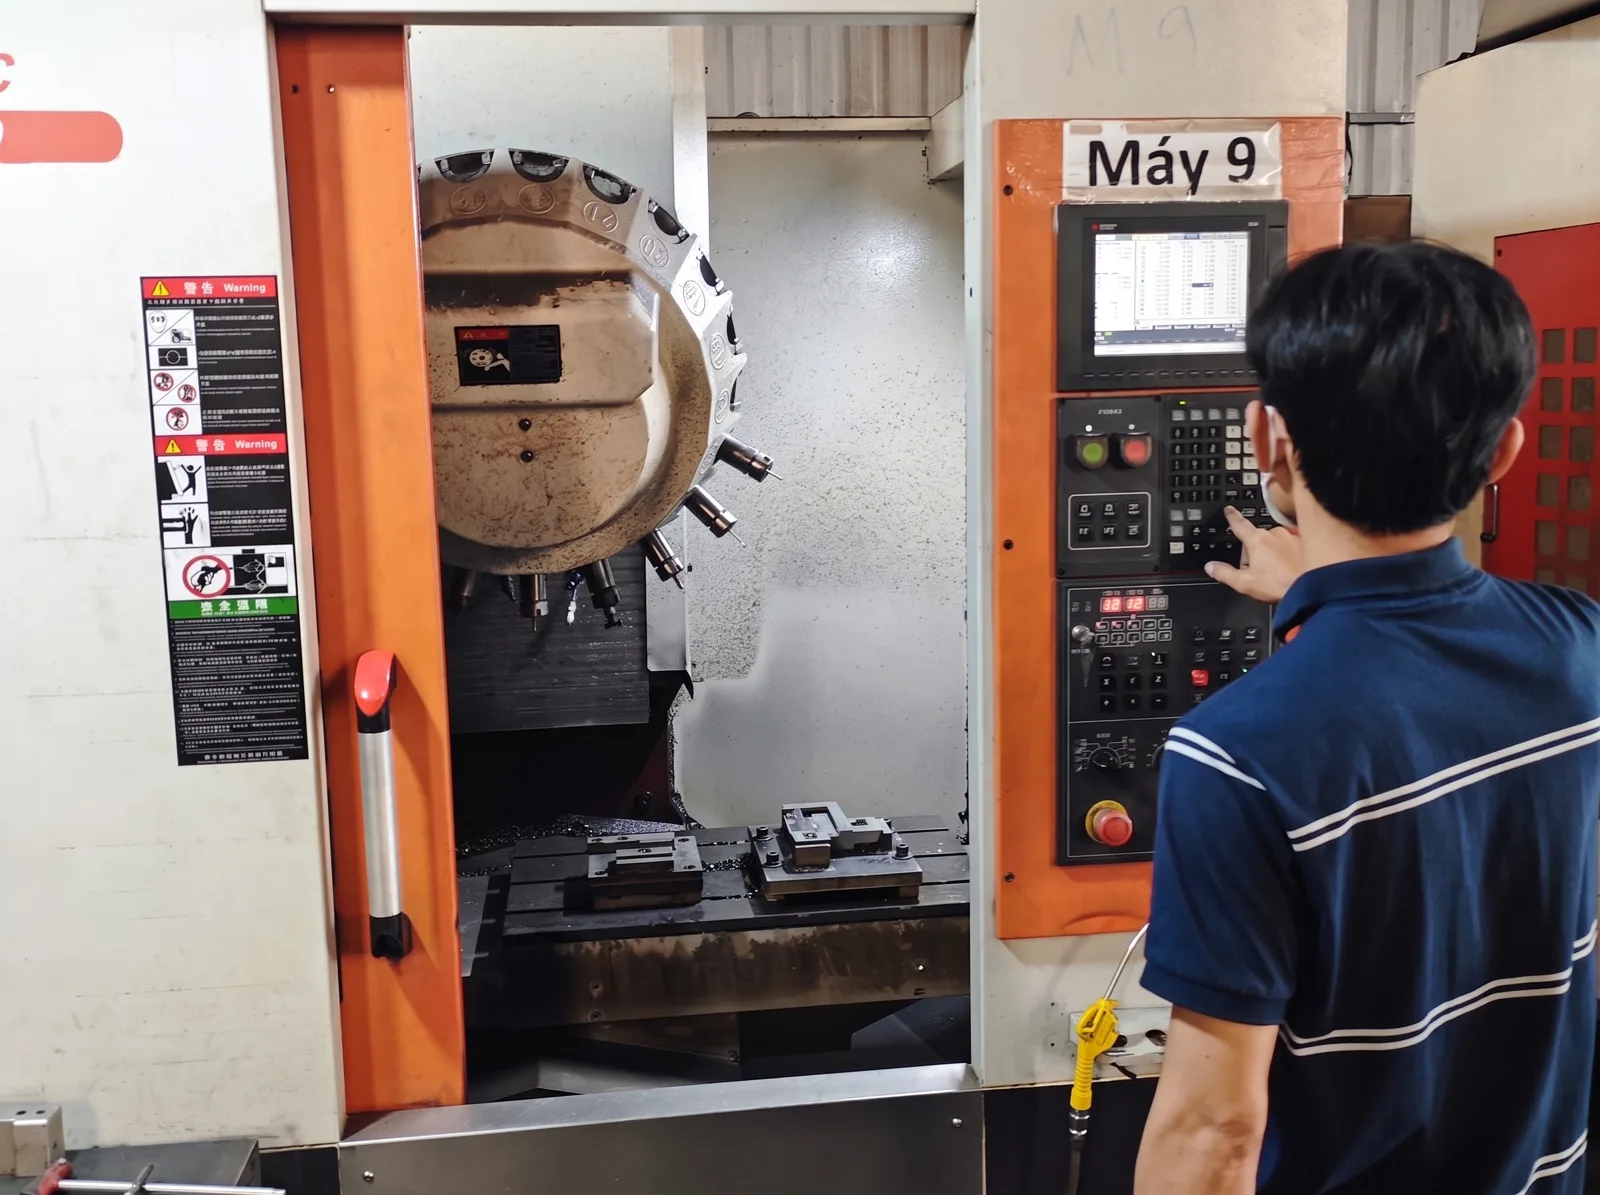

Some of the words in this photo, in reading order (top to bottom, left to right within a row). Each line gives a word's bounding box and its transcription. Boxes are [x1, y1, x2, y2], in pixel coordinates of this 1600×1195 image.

[1089, 135, 1210, 196] Máy
[1226, 136, 1257, 184] 9
[223, 282, 267, 294] Warning
[234, 438, 278, 450] Warning
